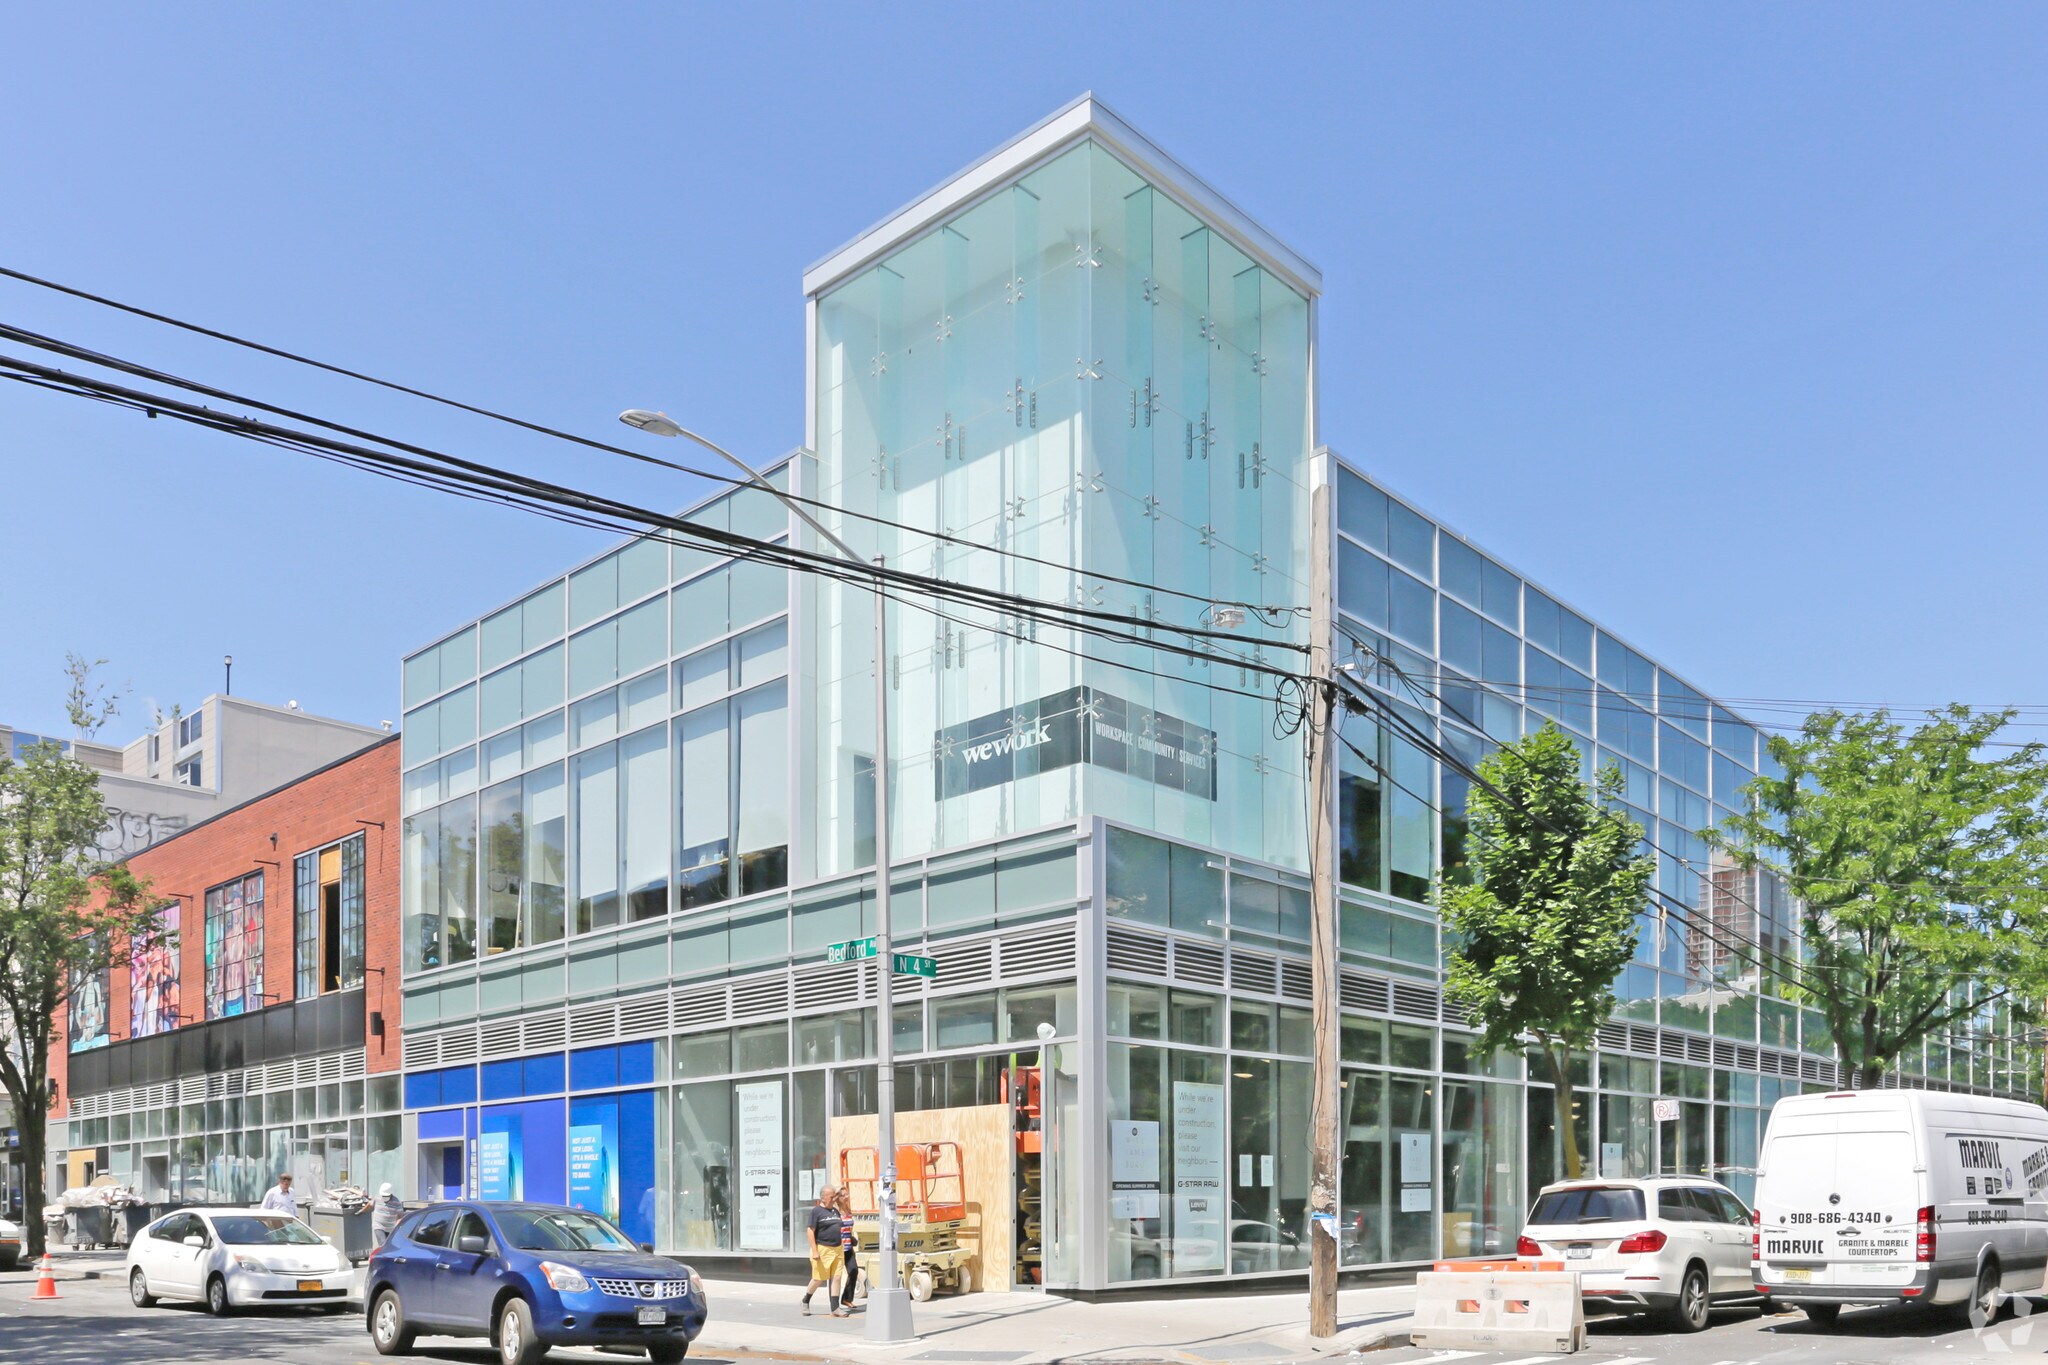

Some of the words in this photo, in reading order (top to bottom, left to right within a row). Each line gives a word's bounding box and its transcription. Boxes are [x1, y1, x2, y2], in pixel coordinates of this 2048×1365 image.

[961, 716, 1052, 765] wework
[1095, 721, 1133, 746] WORKSPACE
[828, 940, 867, 962] Bedford
[899, 956, 908, 973] N
[913, 958, 921, 974] 4
[1958, 1139, 2002, 1169] MARVIC
[1177, 1180, 1203, 1188] G-STAR
[1203, 1180, 1219, 1188] RAW
[1790, 1212, 1881, 1224] 908-686-4340
[1767, 1239, 1824, 1254] MARVIC
[1838, 1239, 1869, 1247] GRANITE
[1869, 1239, 1876, 1247] &
[1877, 1239, 1909, 1247] MARBLE
[1848, 1248, 1898, 1256] COUNTERTOPS
